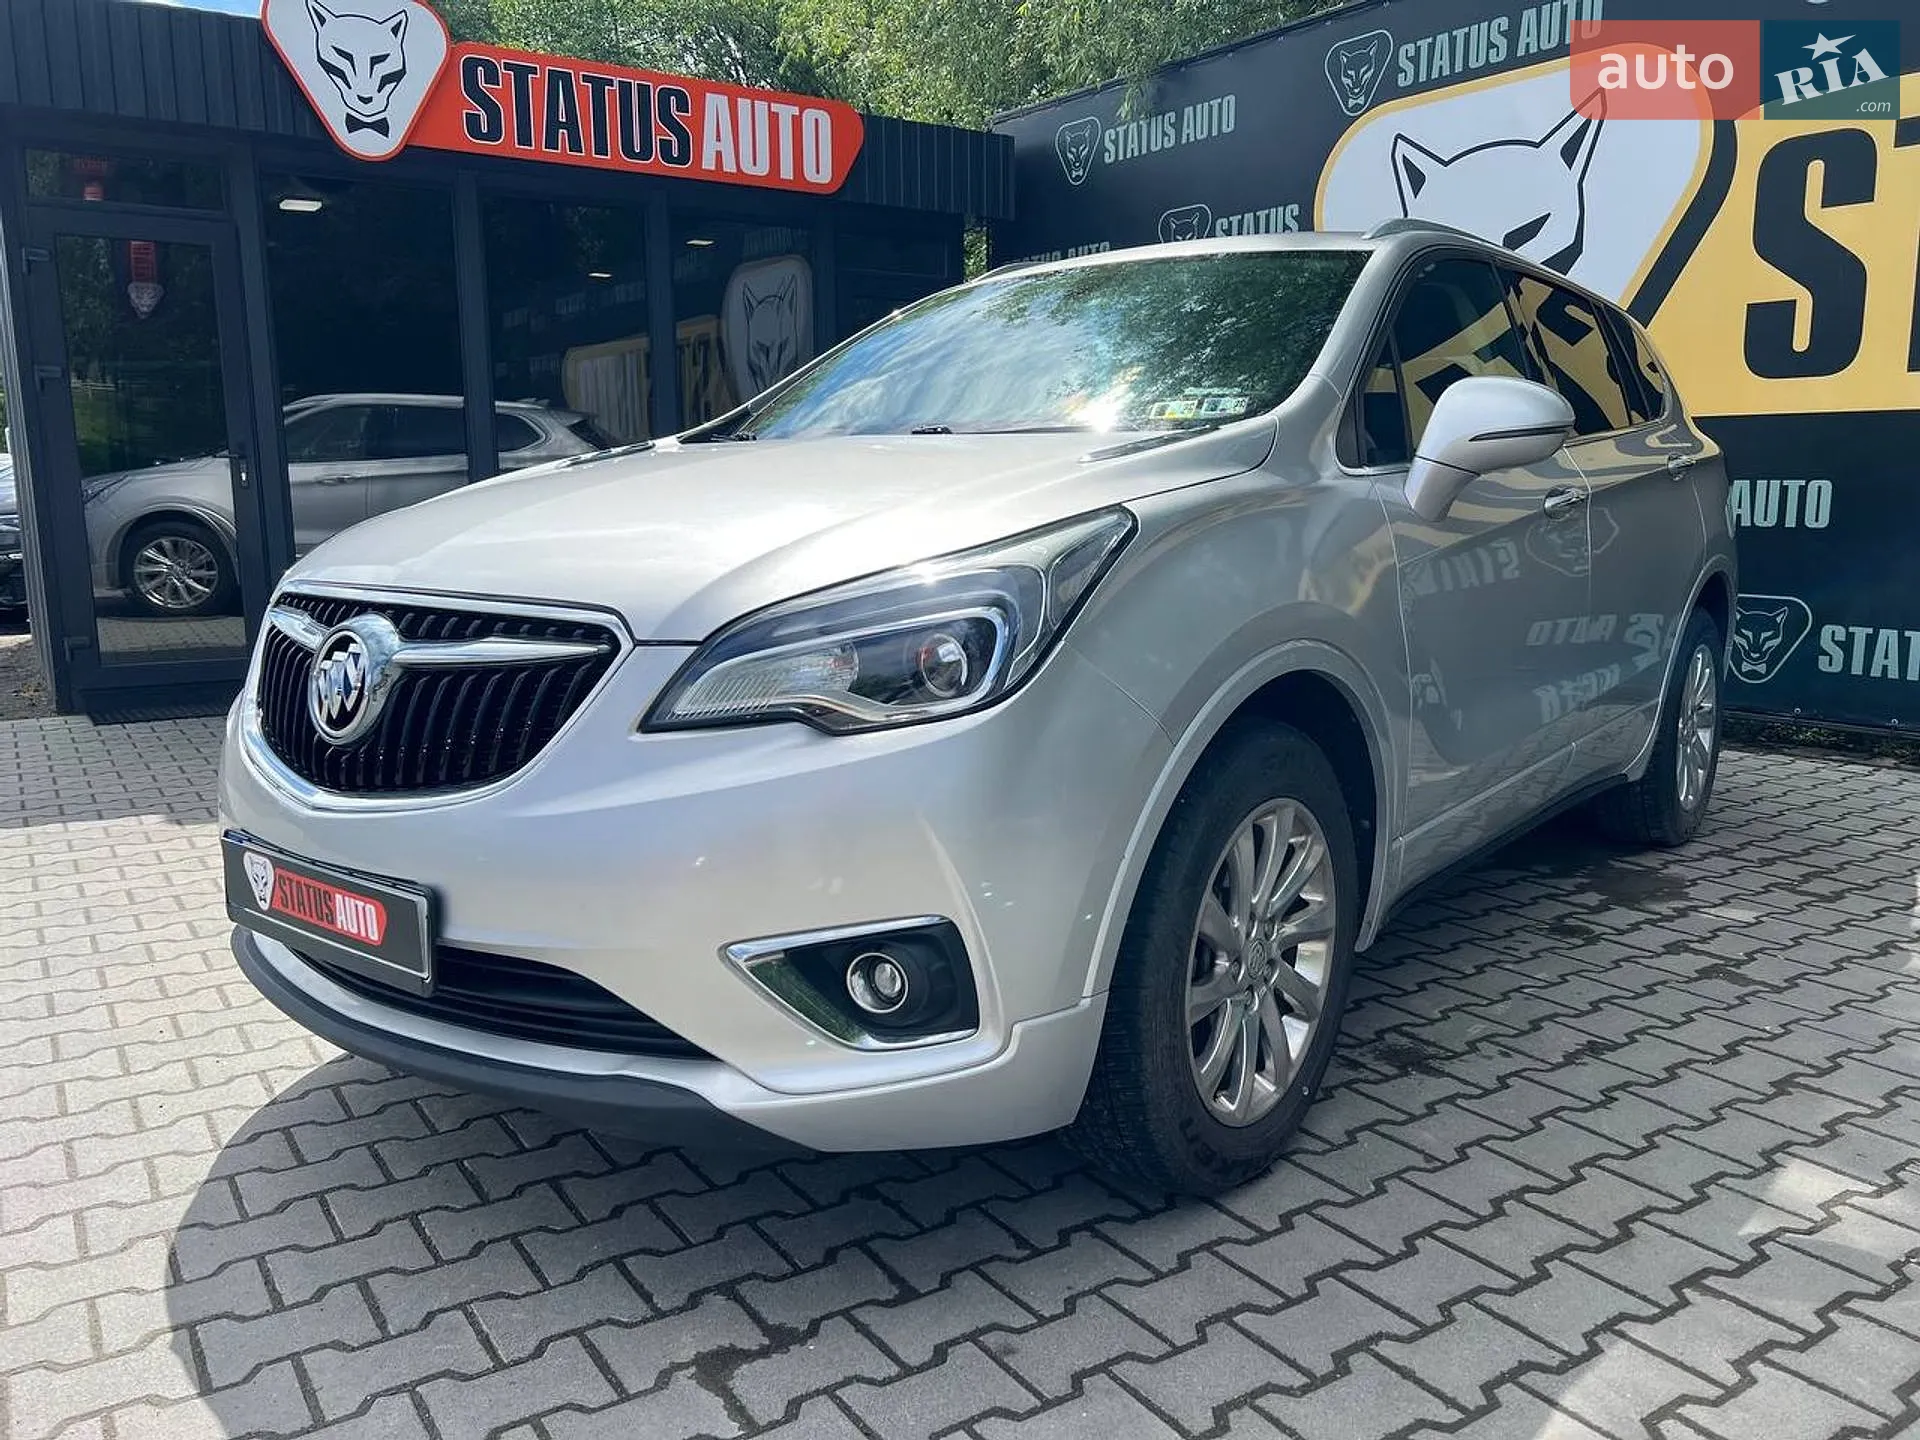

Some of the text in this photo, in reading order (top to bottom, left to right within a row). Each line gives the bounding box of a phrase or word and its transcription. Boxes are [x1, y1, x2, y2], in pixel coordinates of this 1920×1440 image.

[1397, 0, 1602, 88] STATUS AUTO
[460, 54, 833, 184] STATUS AUTO
[1103, 94, 1236, 164] STATUS AUTO
[1732, 479, 1833, 529] AUTO
[277, 875, 379, 941] STATUS AUTO
